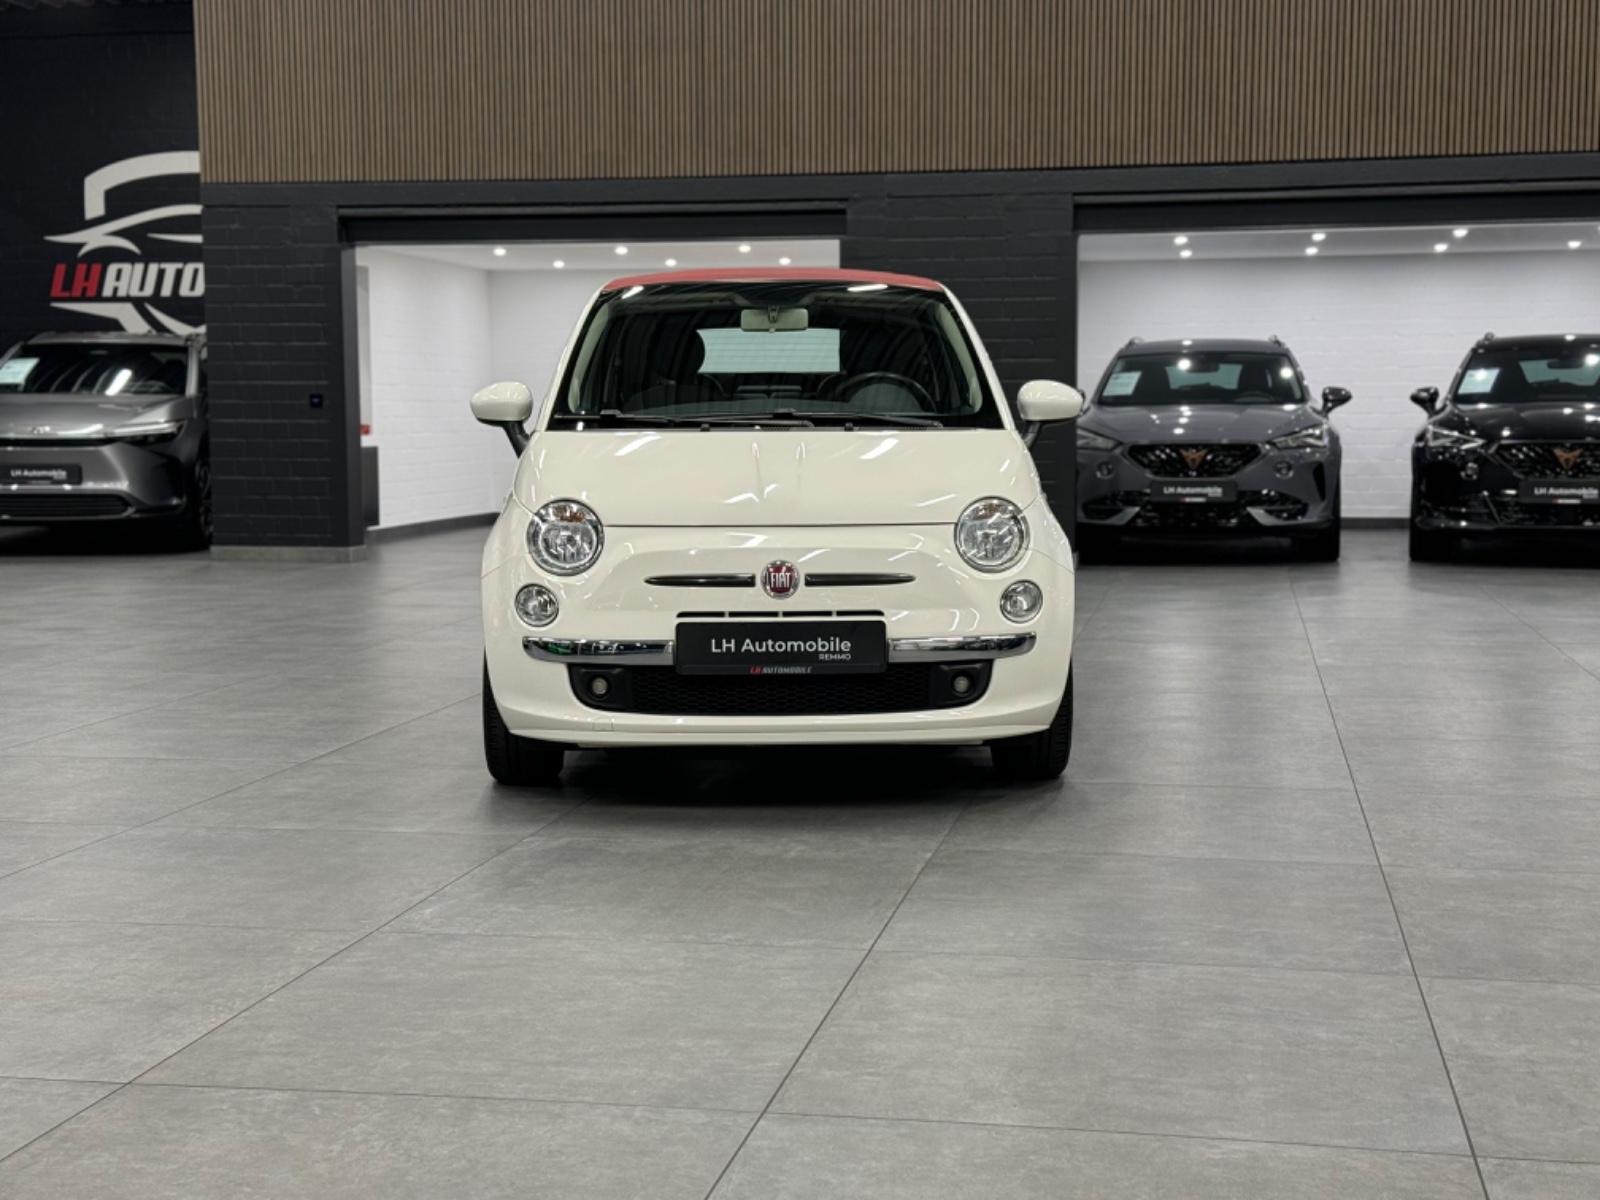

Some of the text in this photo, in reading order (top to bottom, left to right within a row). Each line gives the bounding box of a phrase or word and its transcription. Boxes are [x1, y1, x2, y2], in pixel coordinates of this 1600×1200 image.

[770, 572, 792, 589] FIAT
[710, 637, 852, 653] LH Automobile
